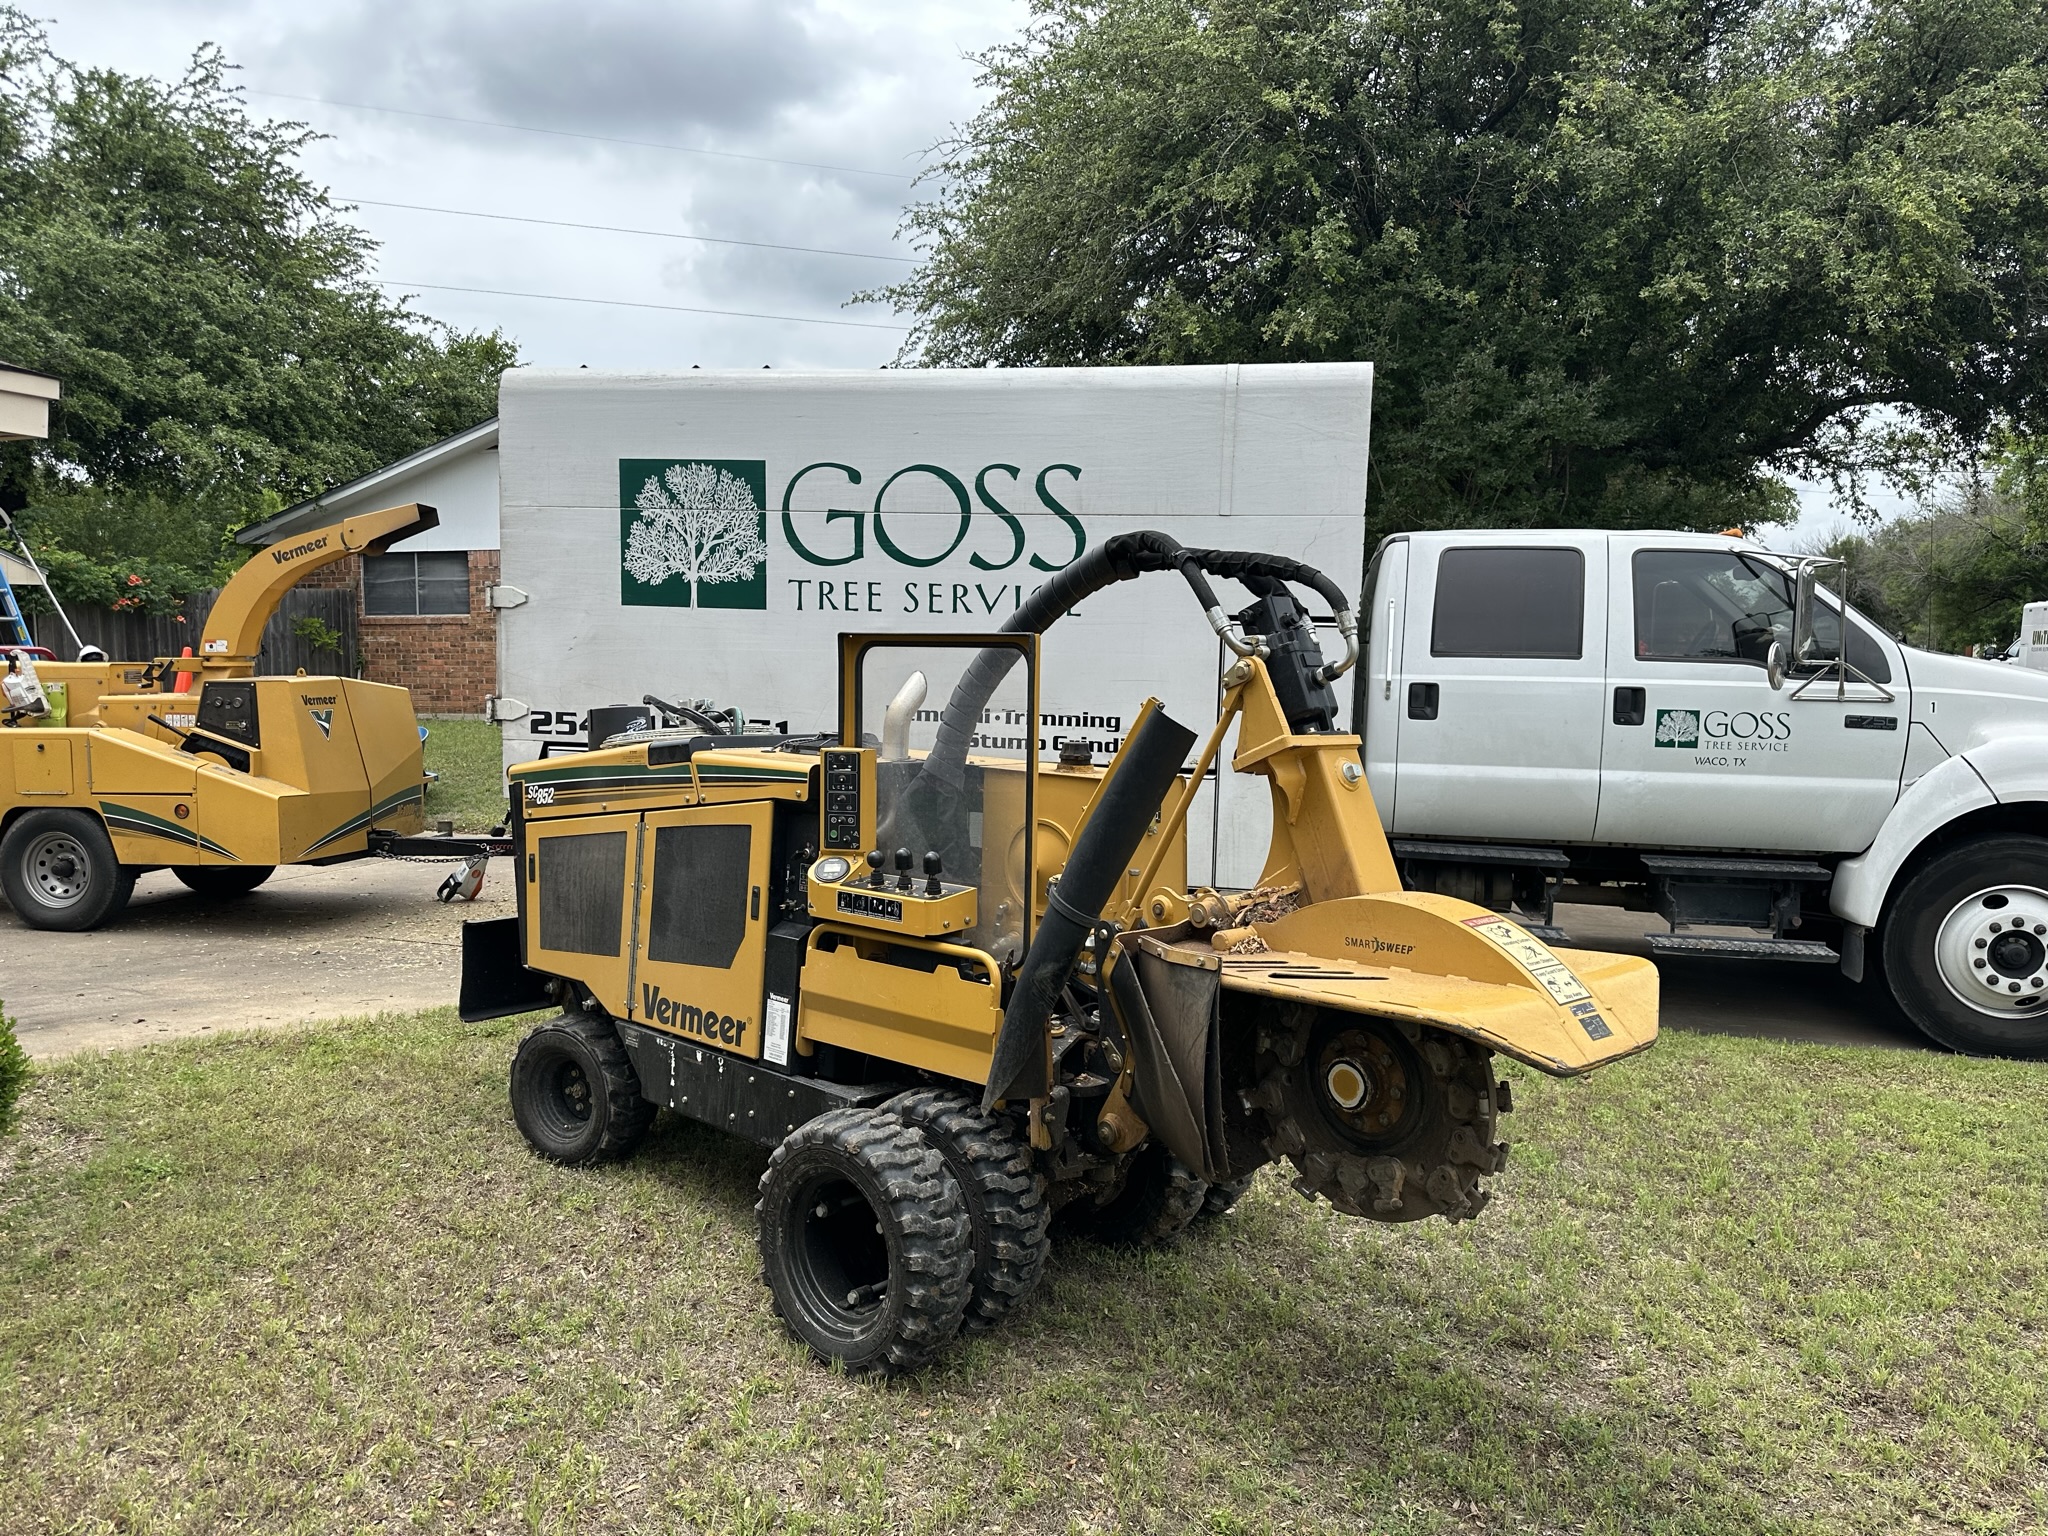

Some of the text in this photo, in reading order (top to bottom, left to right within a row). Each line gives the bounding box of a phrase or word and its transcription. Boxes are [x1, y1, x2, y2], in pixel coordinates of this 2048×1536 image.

[782, 462, 1087, 572] GOSS
[272, 536, 328, 564] Vermeer
[788, 579, 1082, 617] TREE SERVI
[301, 694, 337, 706] Vermeer
[1930, 701, 1936, 713] 1
[1002, 708, 1121, 732] Trmming
[1703, 710, 1791, 740] GOSS
[1704, 741, 1789, 752] TREE SERVICE
[1694, 756, 1747, 767] WACO, TX
[1344, 936, 1414, 955] SMART SWEEP
[643, 982, 747, 1048] Vermeer
